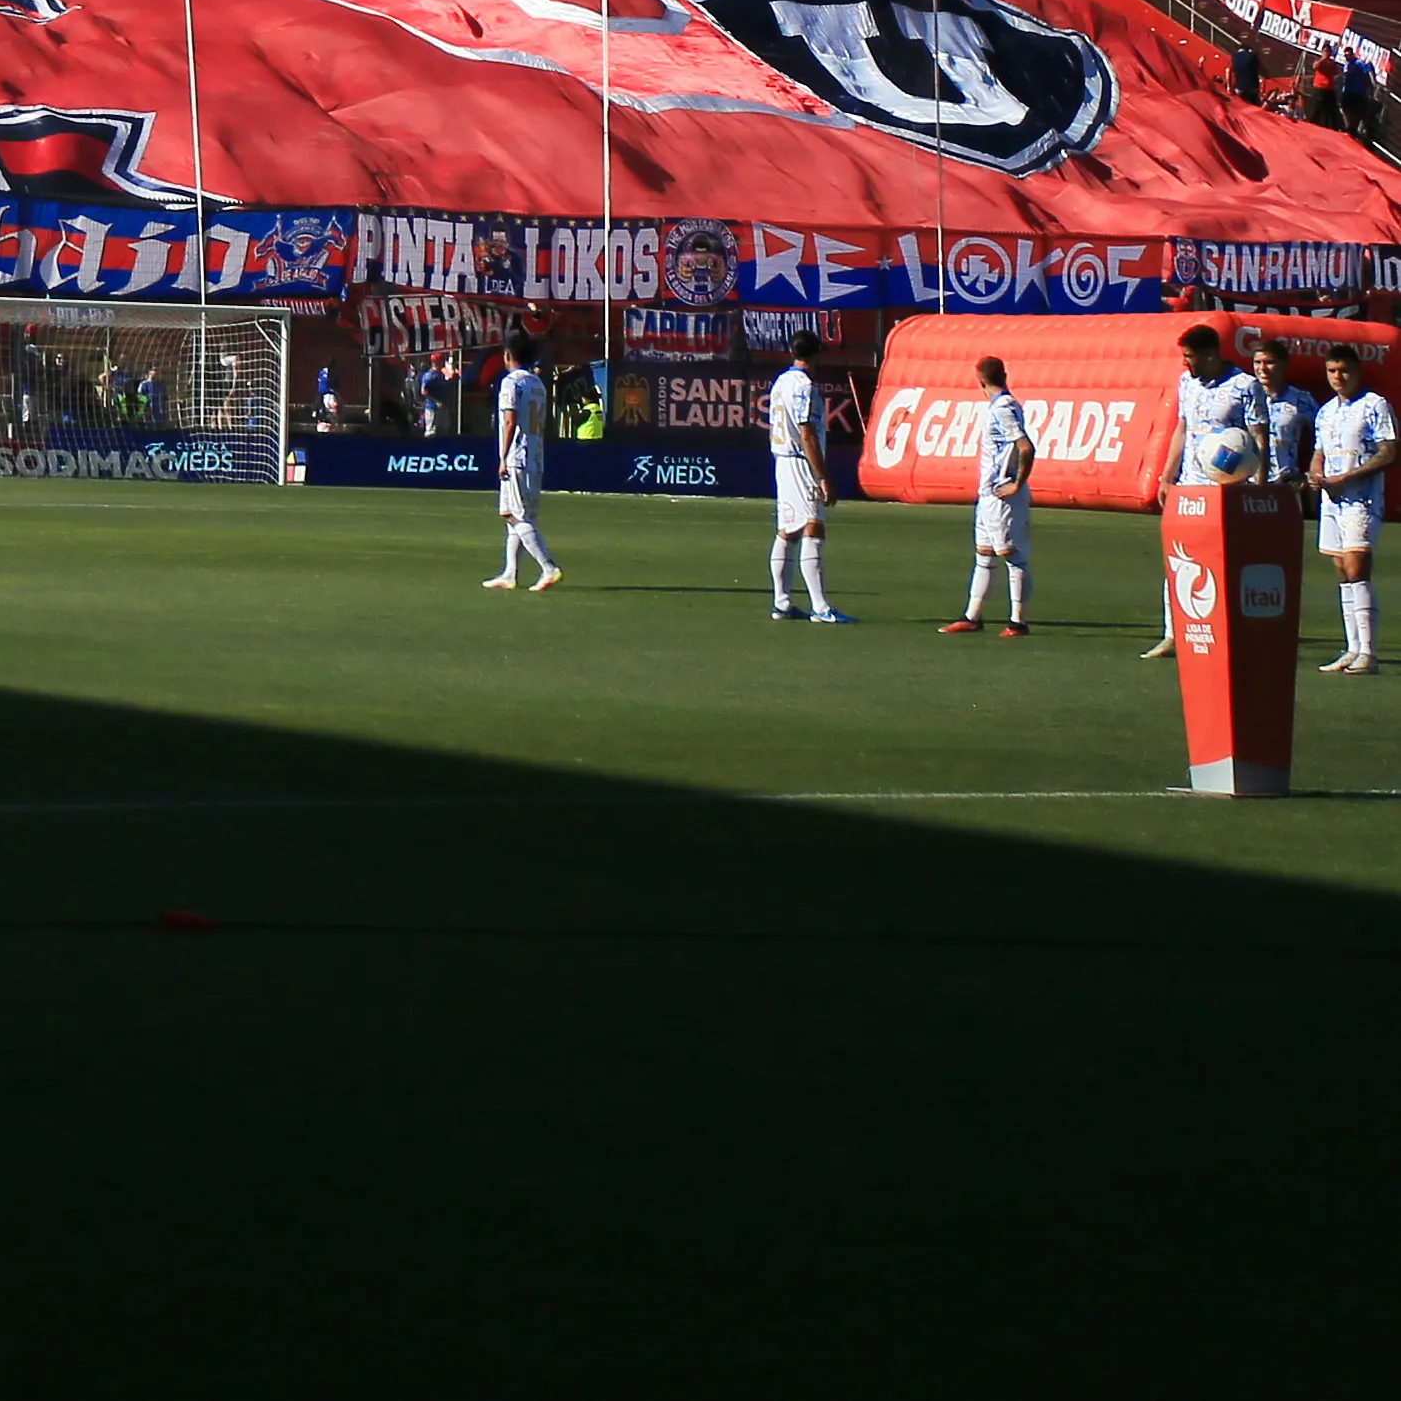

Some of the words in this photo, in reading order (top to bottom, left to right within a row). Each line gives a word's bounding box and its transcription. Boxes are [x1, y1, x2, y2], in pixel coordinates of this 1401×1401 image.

[353, 212, 478, 294] PINTA
[524, 227, 659, 301] LOKOS
[1201, 240, 1260, 293] SAN
[1264, 240, 1364, 291] RAMON
[915, 399, 1136, 463] GATRADE
[168, 450, 234, 473] MEDS
[387, 453, 479, 474] MEDS.CL
[655, 464, 716, 486] MEDS
